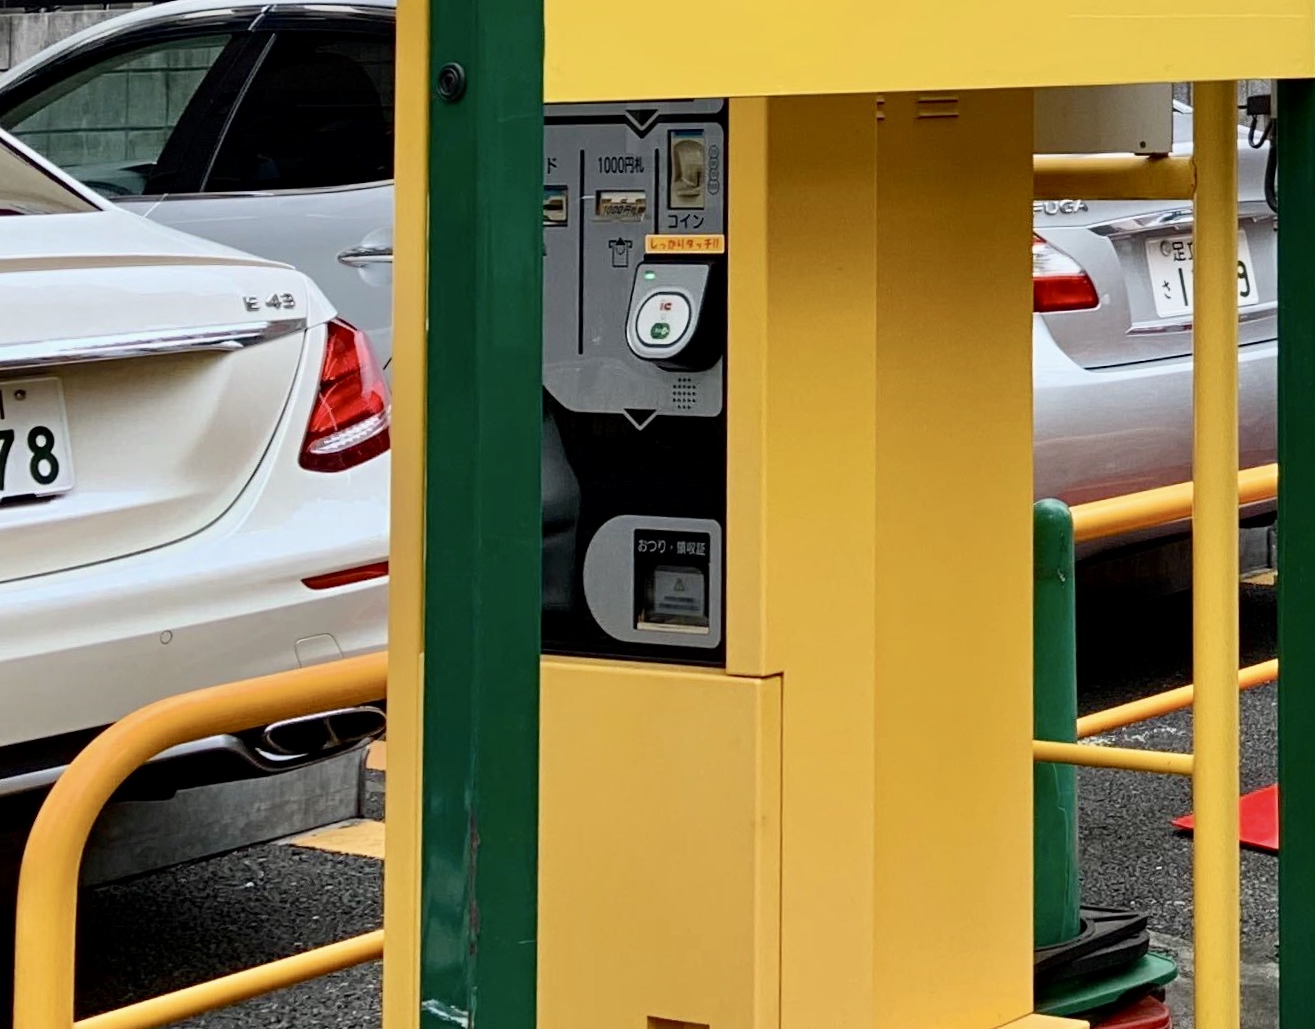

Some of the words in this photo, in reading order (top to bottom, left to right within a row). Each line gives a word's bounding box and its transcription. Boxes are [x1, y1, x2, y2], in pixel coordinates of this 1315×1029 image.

[597, 156, 645, 174] 1000円札
[668, 214, 705, 229] コイン
[242, 295, 260, 312] E
[265, 292, 296, 310] 43
